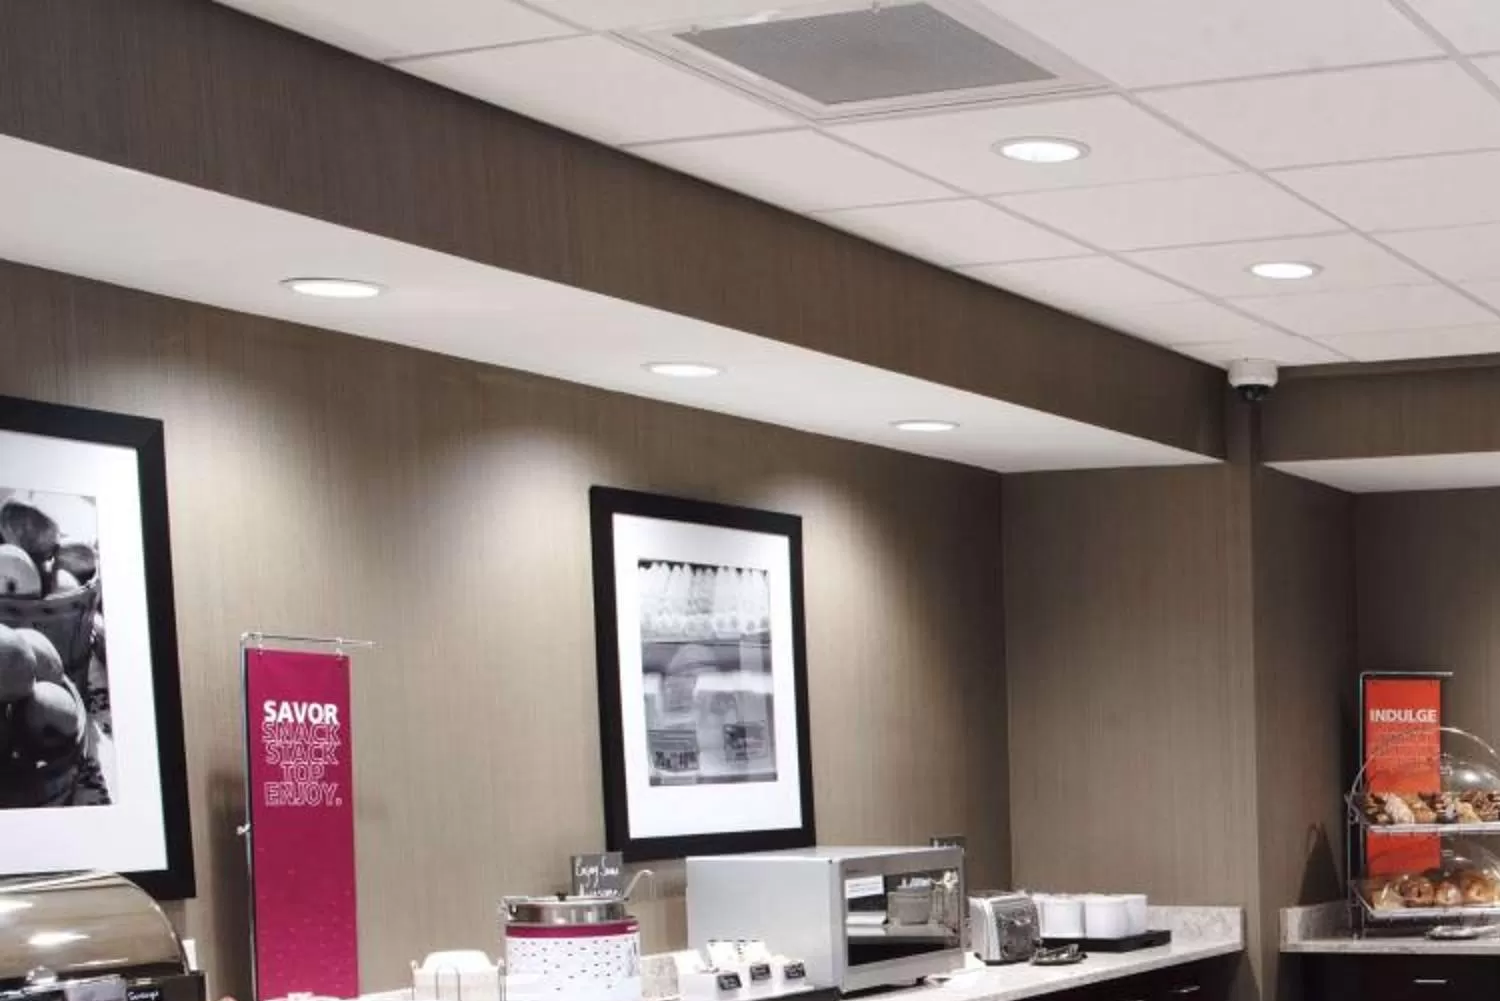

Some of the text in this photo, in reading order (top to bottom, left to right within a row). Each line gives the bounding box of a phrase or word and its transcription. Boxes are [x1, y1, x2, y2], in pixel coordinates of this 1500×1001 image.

[263, 700, 338, 725] SAVOR
[1369, 708, 1438, 723] INDULGE
[261, 721, 341, 745] SNACK
[265, 742, 339, 766] STACK
[281, 763, 325, 783] TOP
